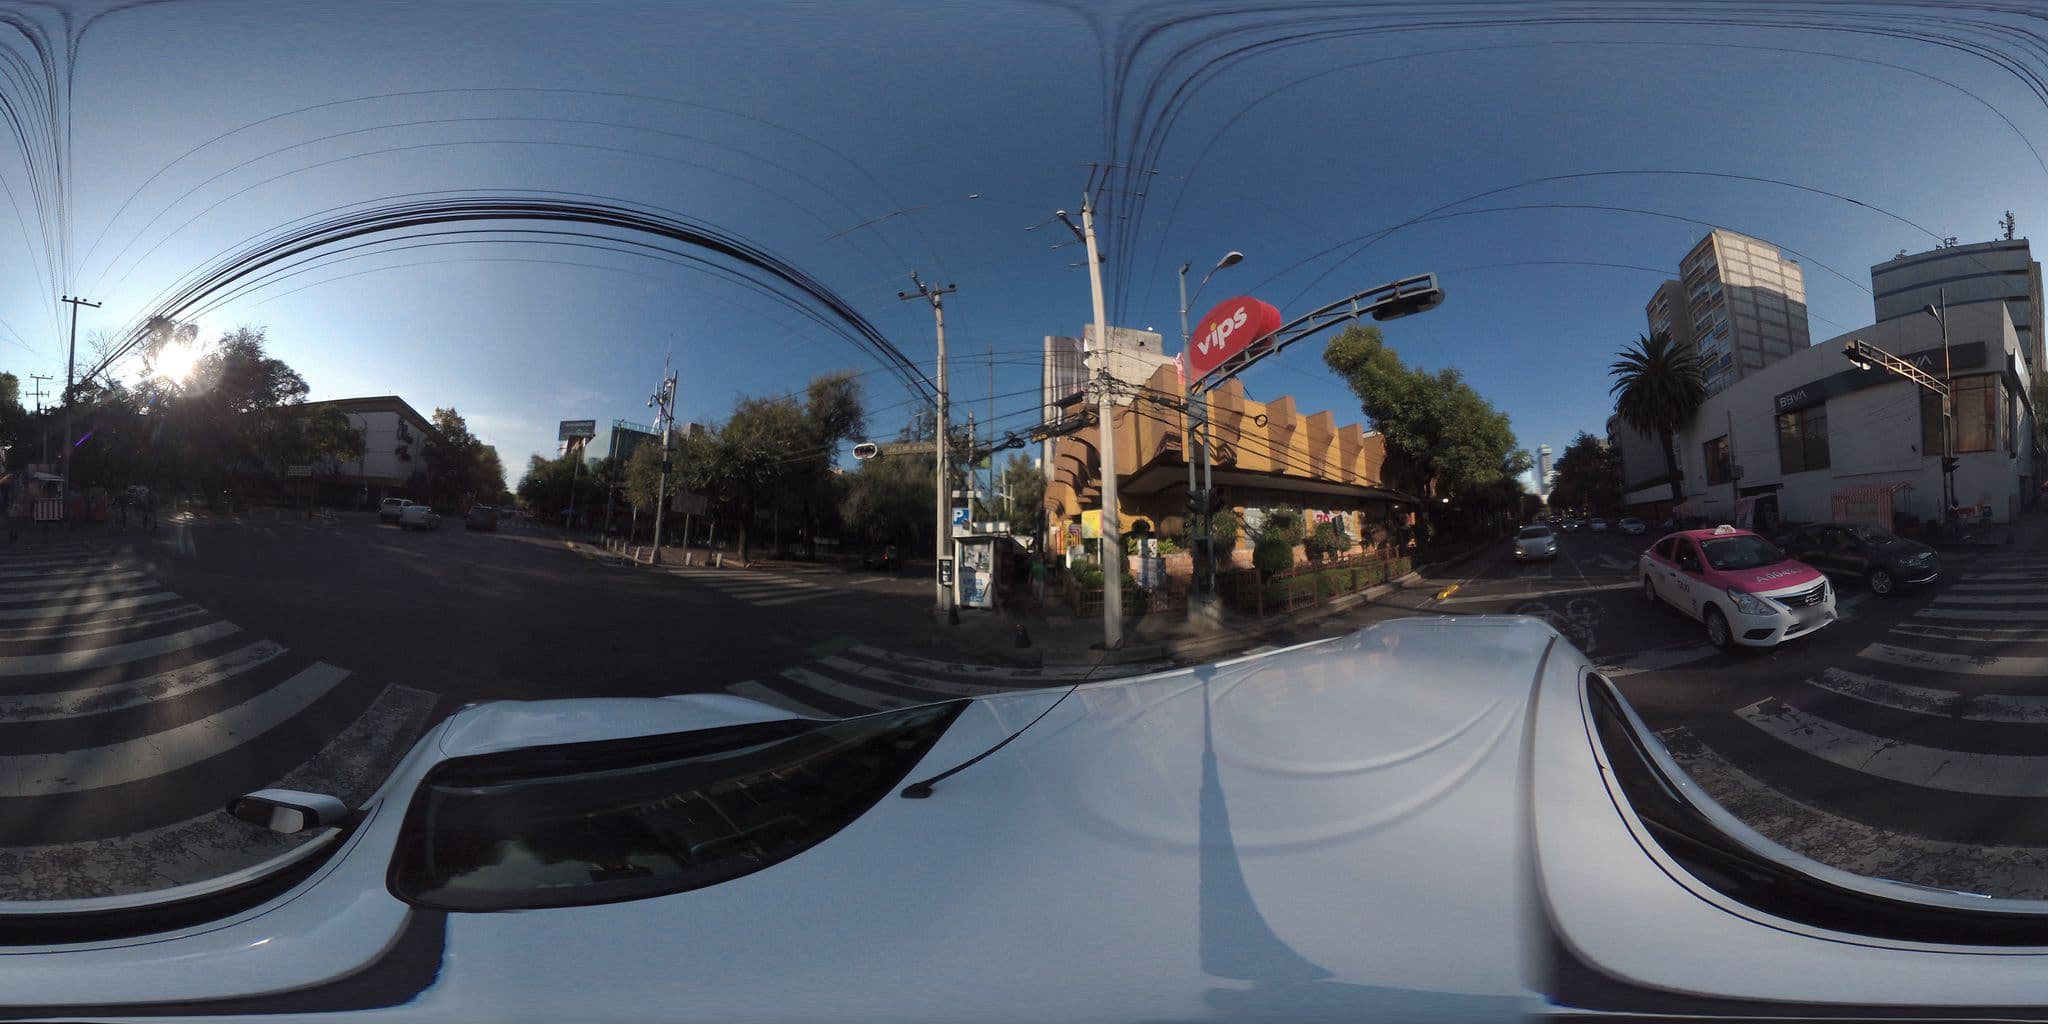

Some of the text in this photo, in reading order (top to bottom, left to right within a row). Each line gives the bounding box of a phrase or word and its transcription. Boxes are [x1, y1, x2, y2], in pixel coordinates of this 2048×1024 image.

[1197, 306, 1248, 355] vips
[1780, 389, 1807, 407] BBVA
[1677, 580, 1690, 592] TAXI
